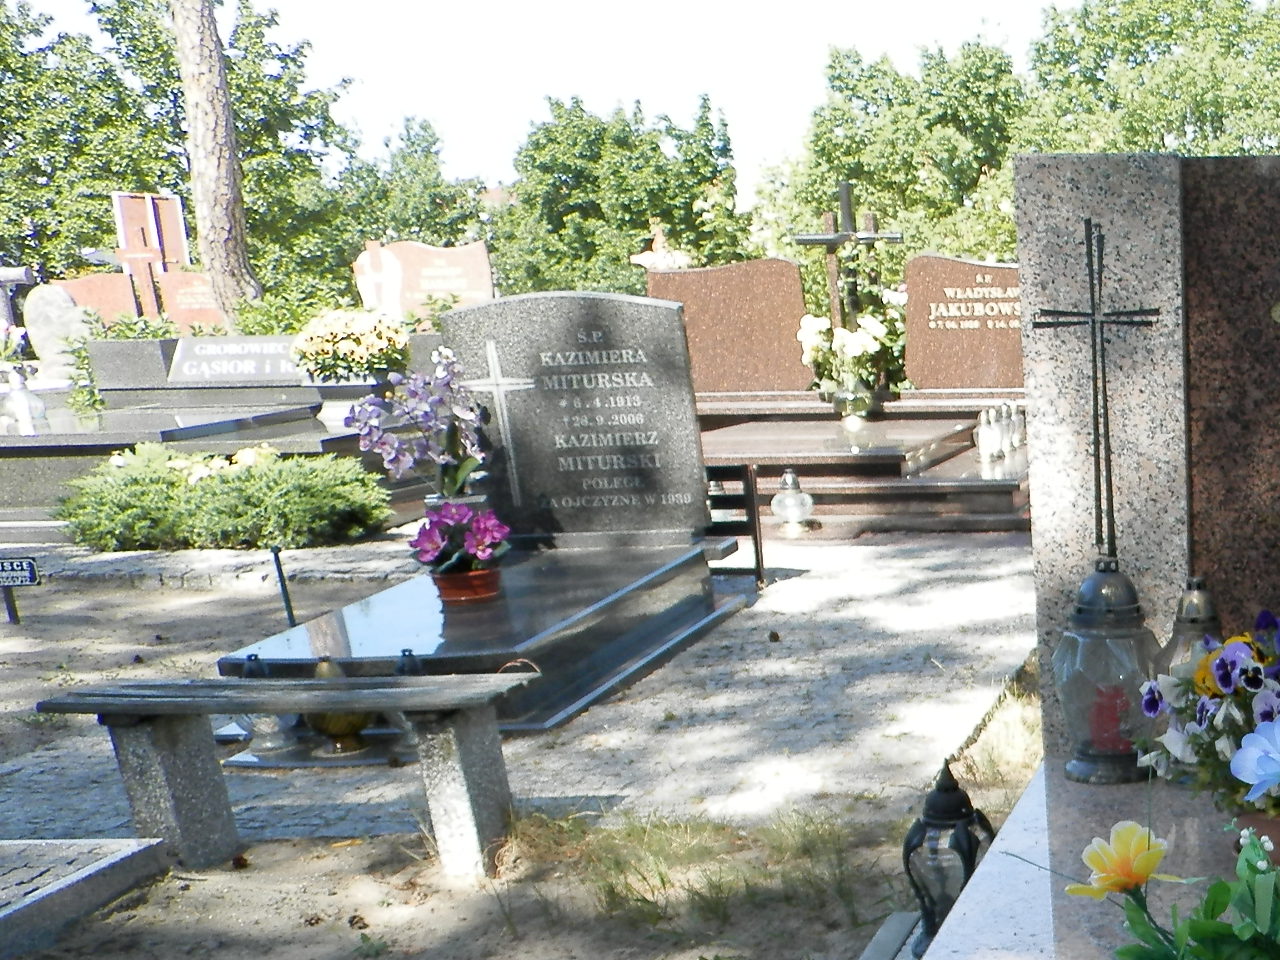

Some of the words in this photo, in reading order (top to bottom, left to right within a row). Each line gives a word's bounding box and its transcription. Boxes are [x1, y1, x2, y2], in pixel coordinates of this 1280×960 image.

[194, 342, 289, 355] GROBOWIEC
[539, 350, 648, 366] KAZIMIERA
[183, 360, 256, 379] GĄSIOR
[543, 372, 654, 390] MITURSKA
[555, 431, 658, 448] KAZIMIERZ
[558, 453, 662, 471] MITURSKI
[660, 493, 692, 505] 1939
